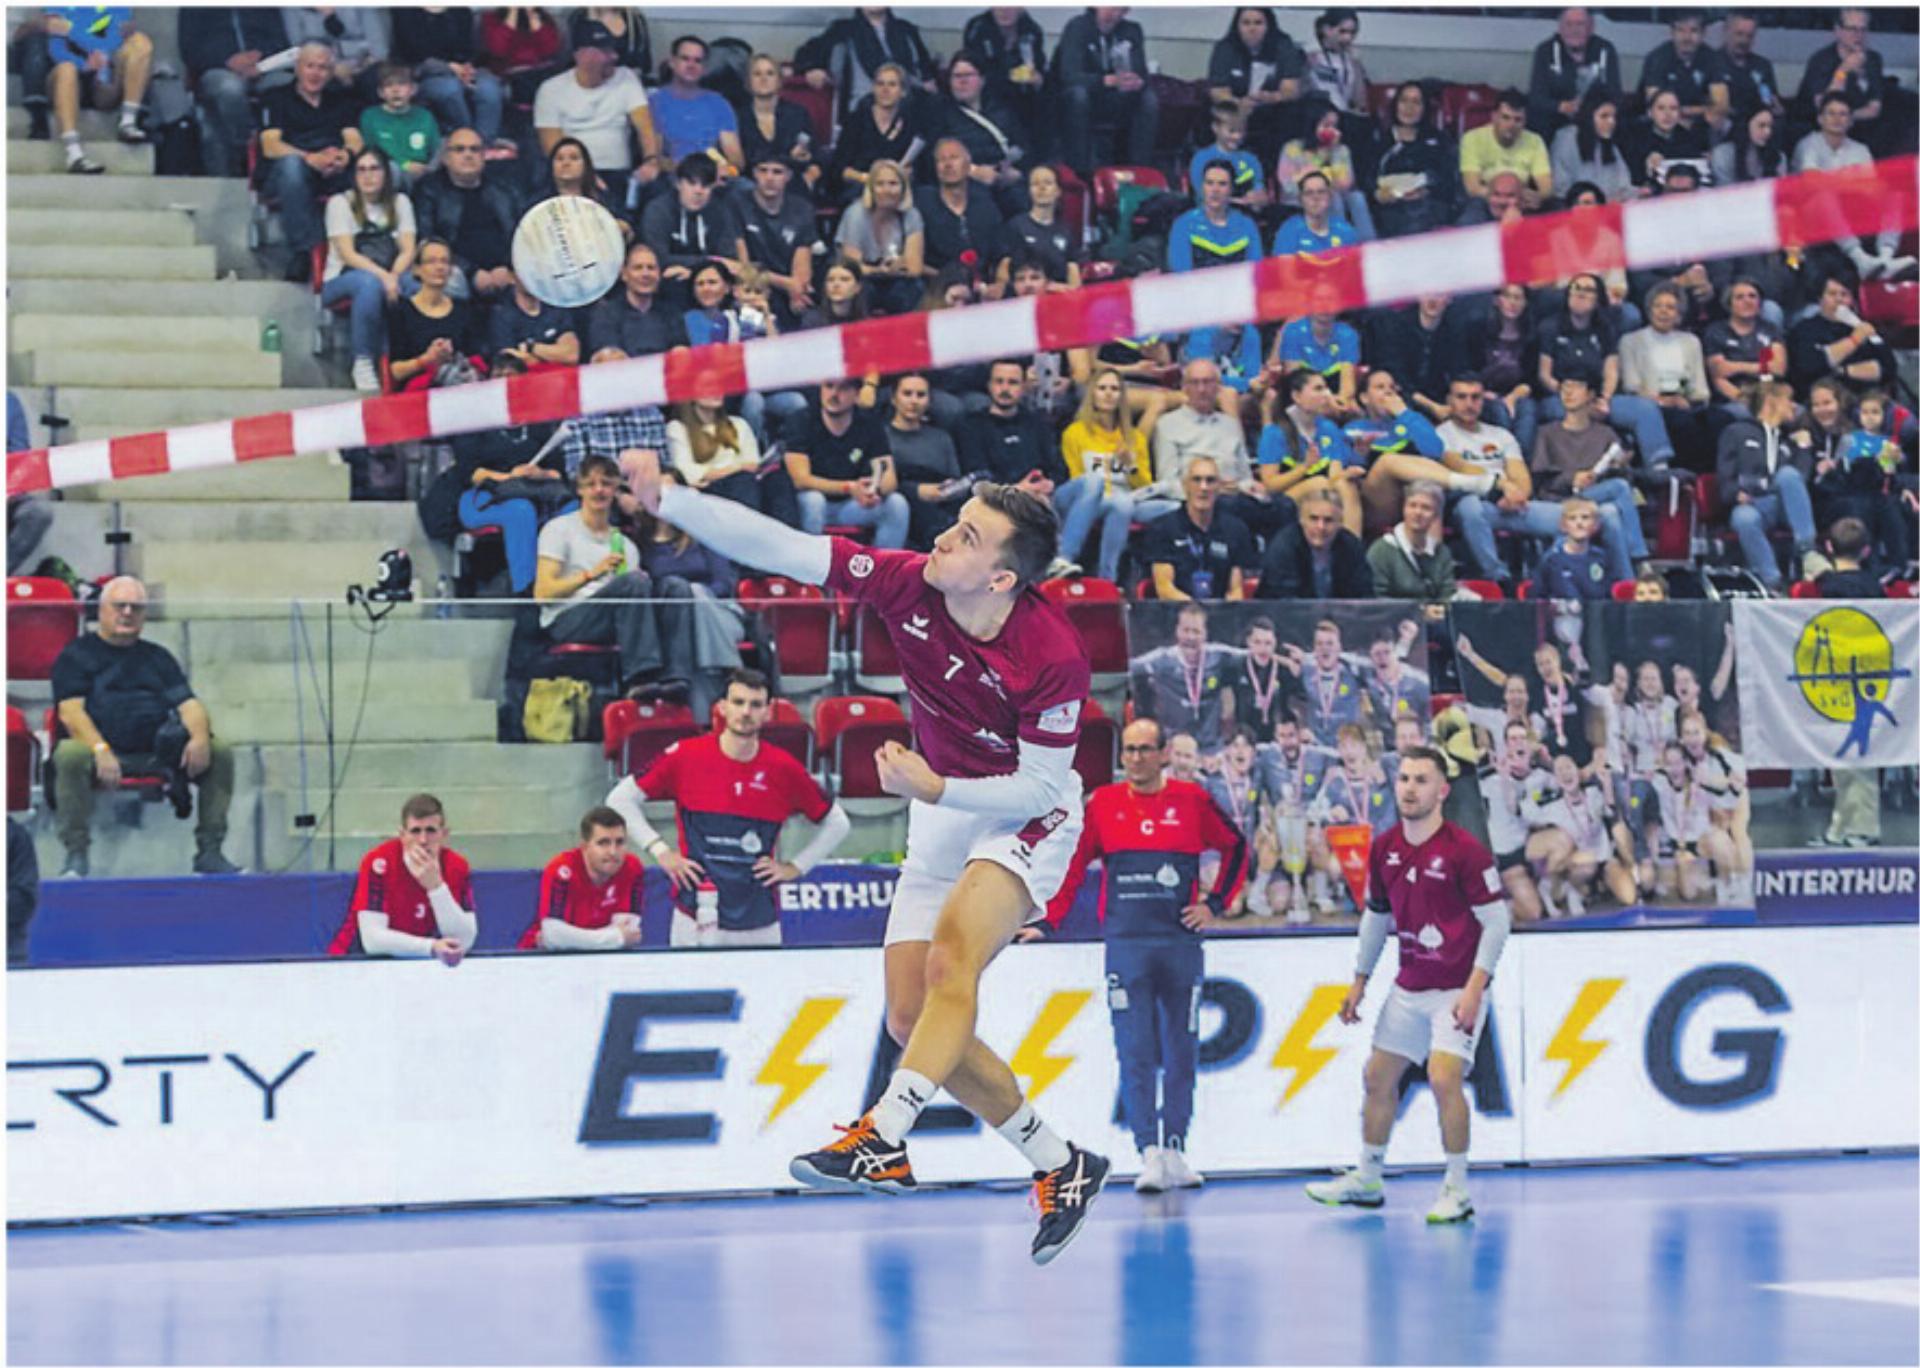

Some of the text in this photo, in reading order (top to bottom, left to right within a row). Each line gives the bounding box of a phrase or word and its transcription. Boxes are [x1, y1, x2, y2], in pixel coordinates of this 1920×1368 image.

[943, 653, 965, 681] 7
[733, 781, 743, 796] 1
[1140, 818, 1155, 836] C
[1405, 866, 1418, 884] 4
[1755, 865, 1917, 897] INTERTHUR
[779, 880, 894, 911] ERTHU
